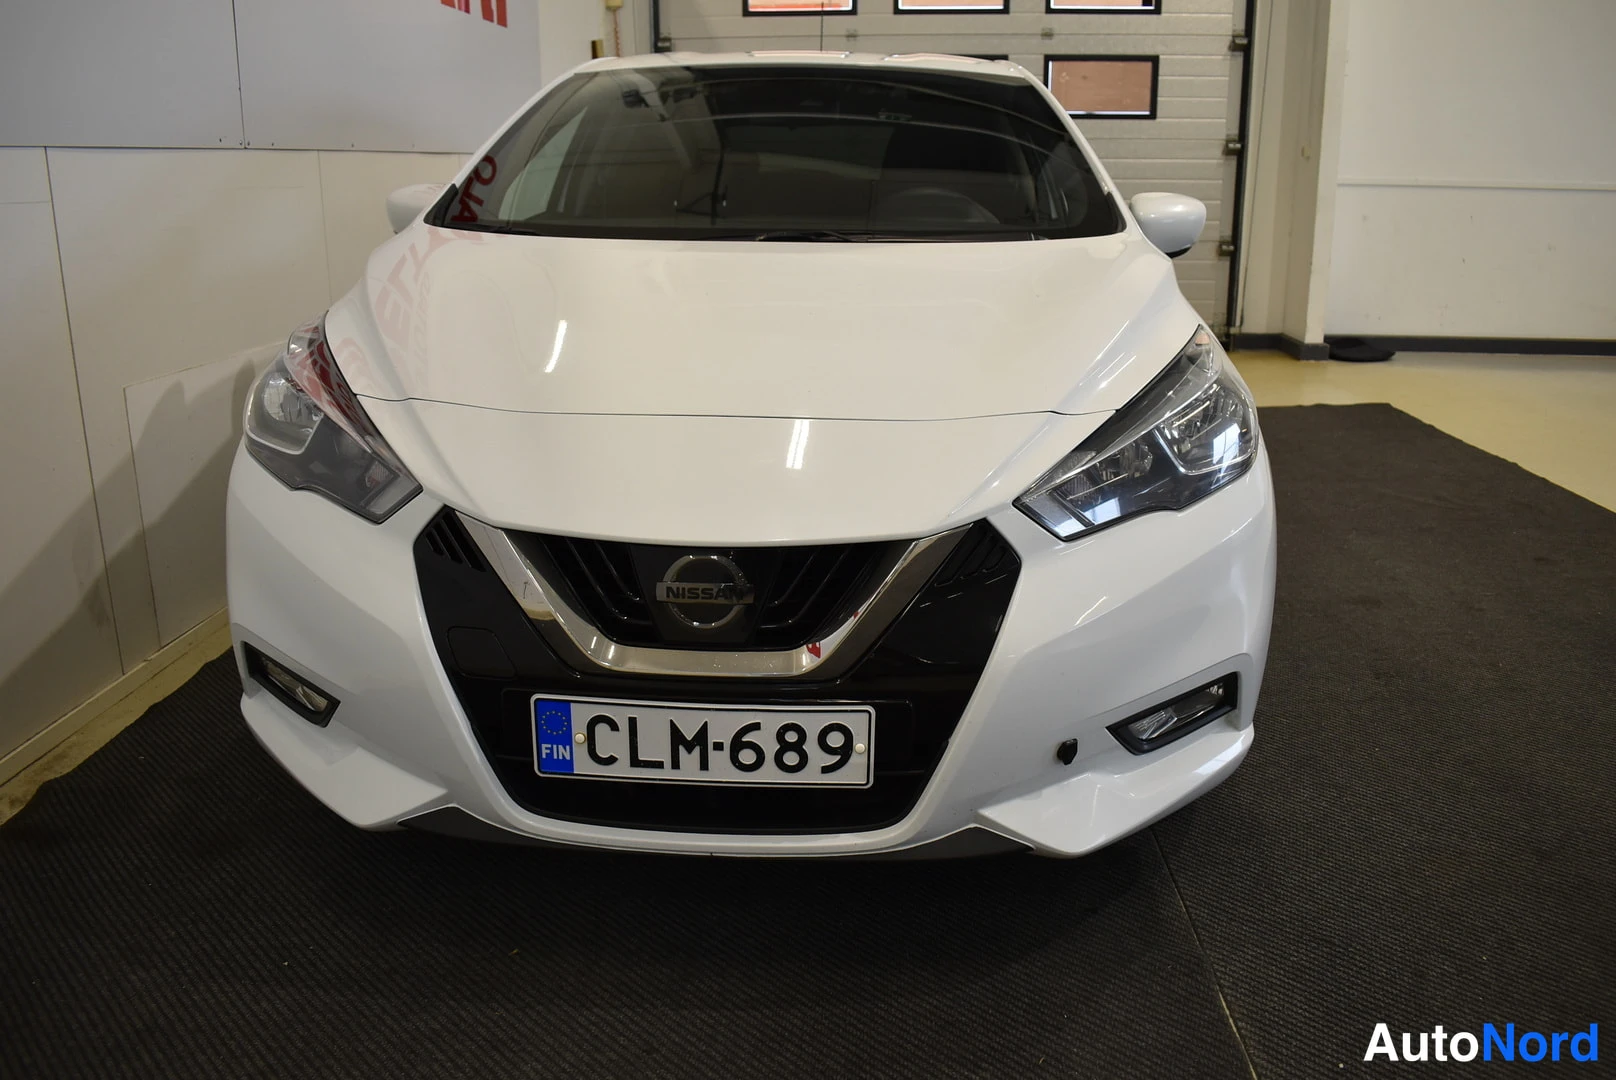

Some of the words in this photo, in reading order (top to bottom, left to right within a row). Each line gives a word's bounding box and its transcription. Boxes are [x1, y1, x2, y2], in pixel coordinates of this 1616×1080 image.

[665, 586, 744, 601] NISSAN
[541, 743, 571, 761] FIN
[586, 713, 854, 775] CLM-689
